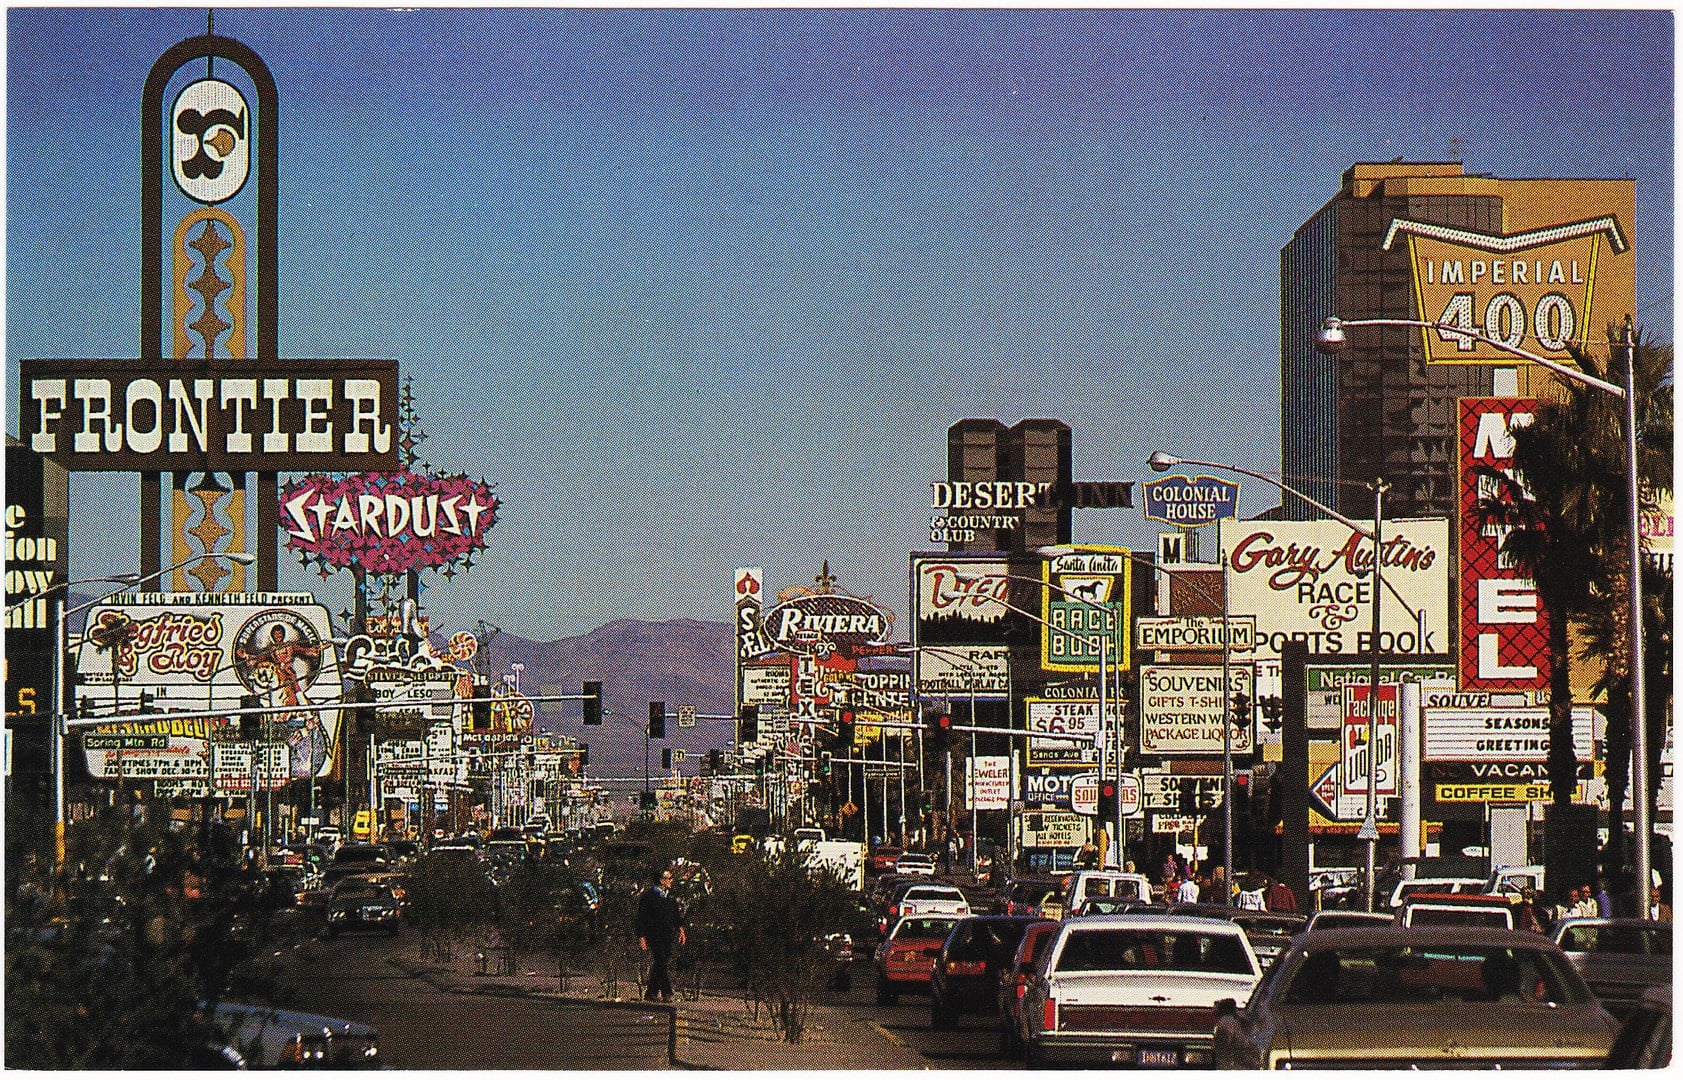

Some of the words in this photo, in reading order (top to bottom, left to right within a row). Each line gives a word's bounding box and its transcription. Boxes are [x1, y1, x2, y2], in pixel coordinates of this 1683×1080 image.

[1427, 259, 1583, 284] IMPERIAL
[1437, 293, 1575, 352] 400
[31, 378, 391, 453] FRONTIER
[1152, 486, 1231, 503] COLONIAL
[285, 488, 488, 543] STARDUST
[1165, 504, 1216, 520] HOUSE
[1056, 555, 1086, 571] Santa
[1088, 555, 1118, 571] Anita
[1231, 532, 1321, 591] Gary
[1318, 530, 1436, 574] Autin's
[173, 594, 193, 604] AND
[195, 592, 240, 604] KENNETH
[245, 592, 268, 604] FELD
[271, 594, 311, 604] PRESENT
[1298, 582, 1370, 604] RACE
[776, 608, 881, 641] RIVIERA
[1186, 618, 1204, 627] The
[1309, 604, 1359, 631] &
[1142, 628, 1249, 645] EMPORIUM
[151, 643, 219, 678] Roy
[156, 687, 167, 697] IN
[1149, 677, 1244, 691] SOUVENIRS
[1054, 704, 1093, 715] STEAK
[1148, 697, 1185, 708] GIFTS
[1145, 713, 1206, 725] WESTERN
[1145, 728, 1199, 740] PACKAGE
[87, 737, 121, 749] Spring
[125, 738, 145, 747] Mtn
[151, 738, 165, 747] Rd
[1033, 751, 1059, 759] Sands
[1064, 751, 1079, 759] Ave
[1441, 787, 1515, 799] COFFEE
